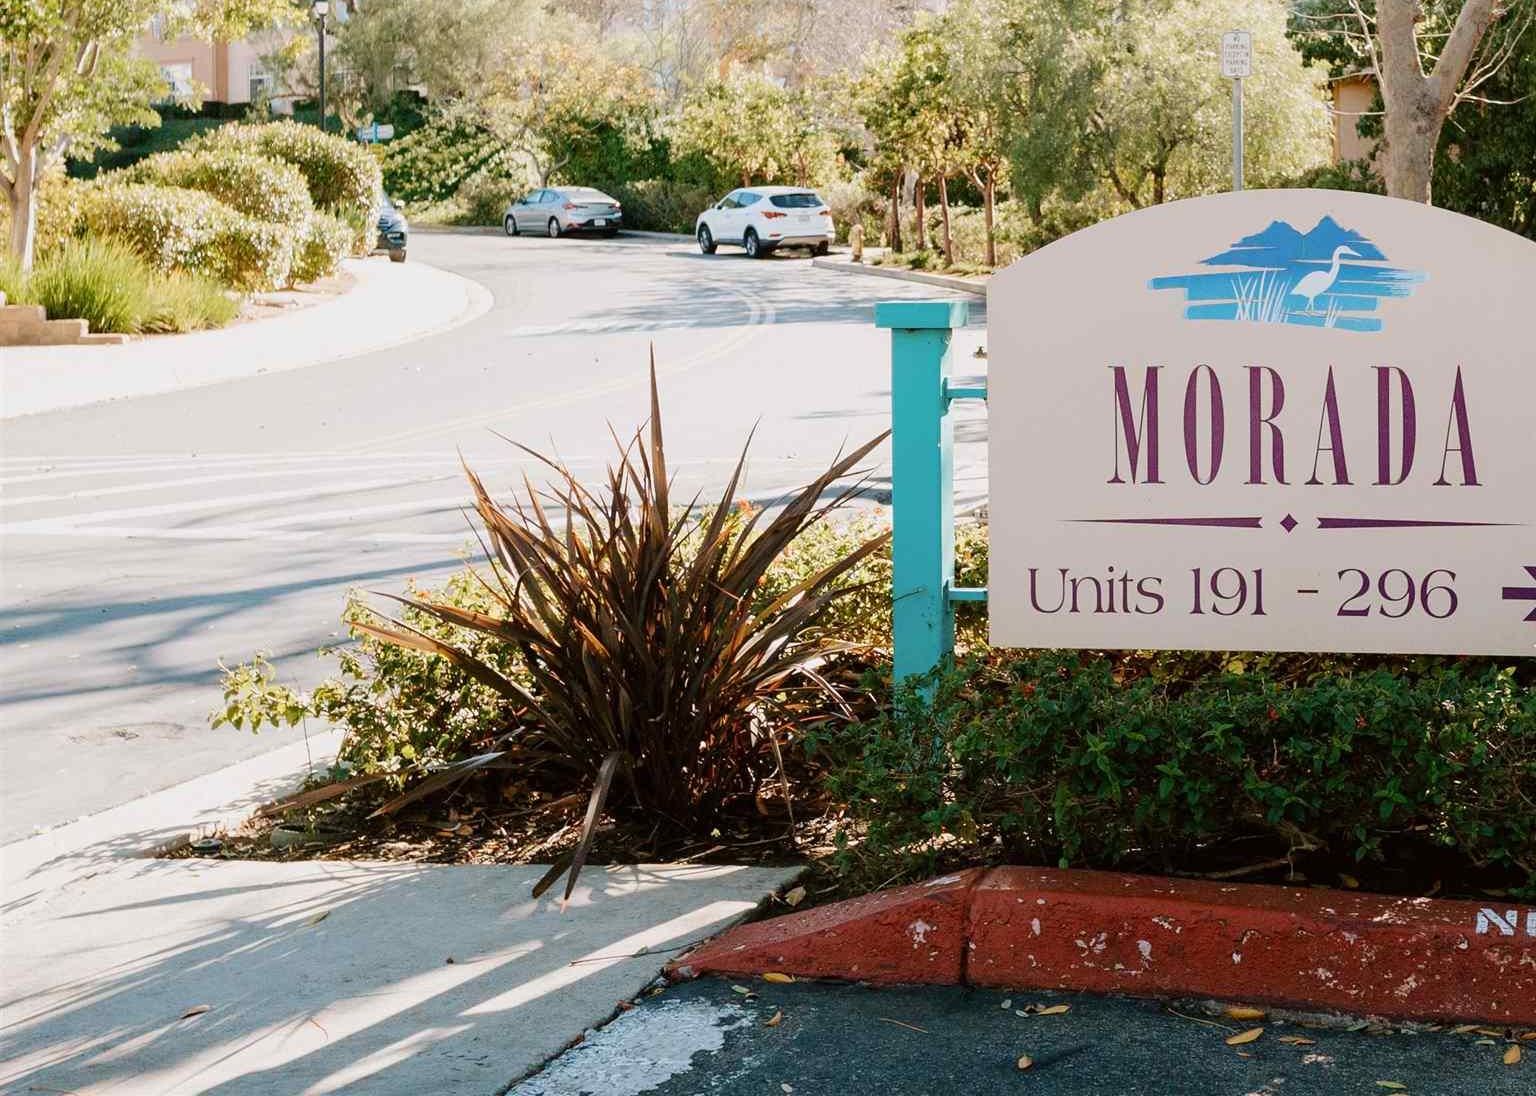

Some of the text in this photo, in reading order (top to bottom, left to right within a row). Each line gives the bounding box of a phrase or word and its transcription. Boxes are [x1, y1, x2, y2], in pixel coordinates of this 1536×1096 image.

[1106, 363, 1484, 488] MORADA
[1028, 566, 1164, 615] Units
[1189, 567, 1268, 617] 191
[1337, 567, 1460, 620] 296
